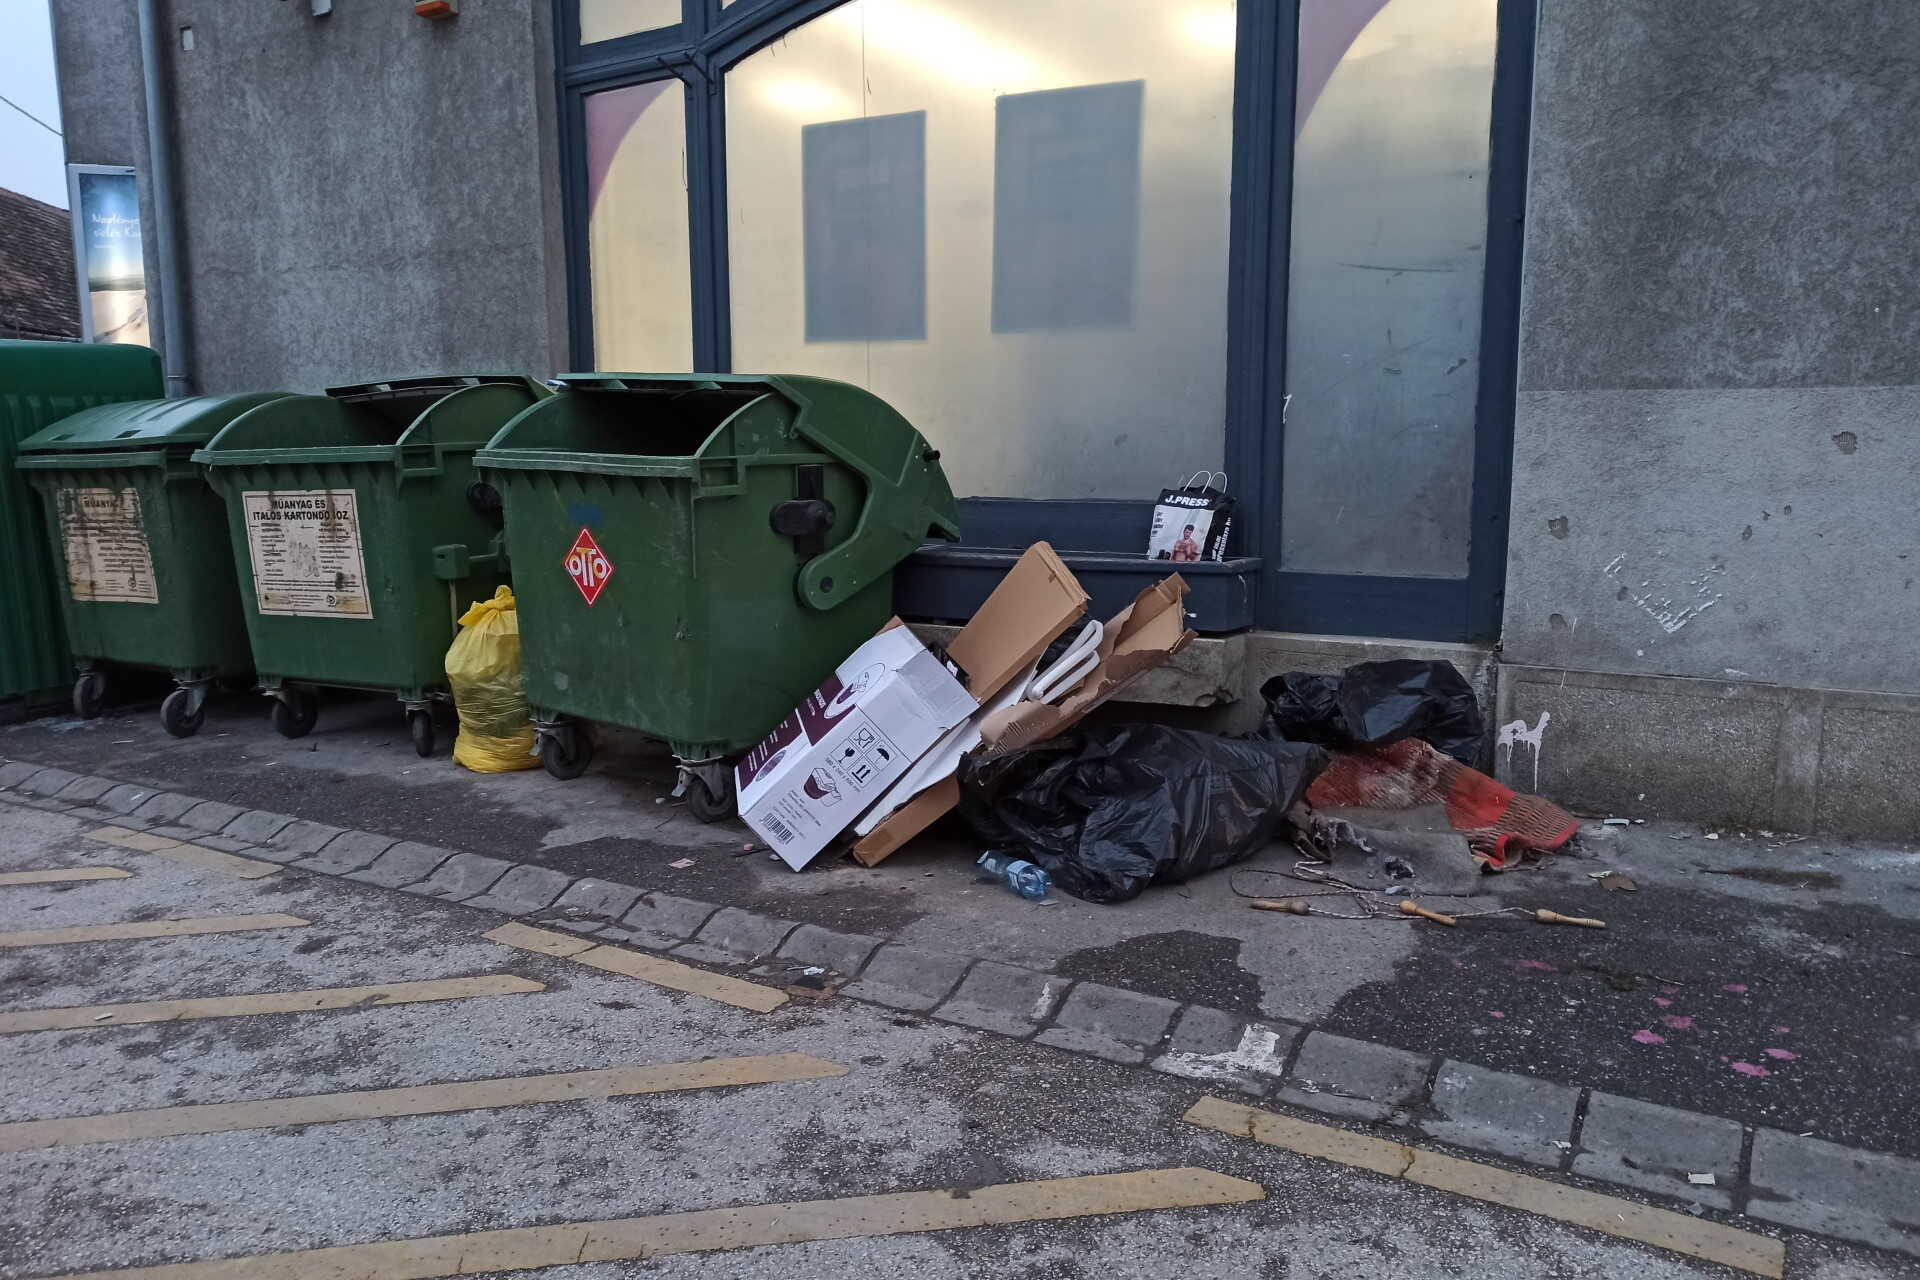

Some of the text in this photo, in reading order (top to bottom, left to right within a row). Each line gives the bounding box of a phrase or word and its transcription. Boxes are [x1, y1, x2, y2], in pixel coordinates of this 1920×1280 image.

[1165, 495, 1209, 506] J.PRESS
[253, 510, 349, 520] ITALOS KARTONDOOZ
[569, 547, 607, 587] OTTO
